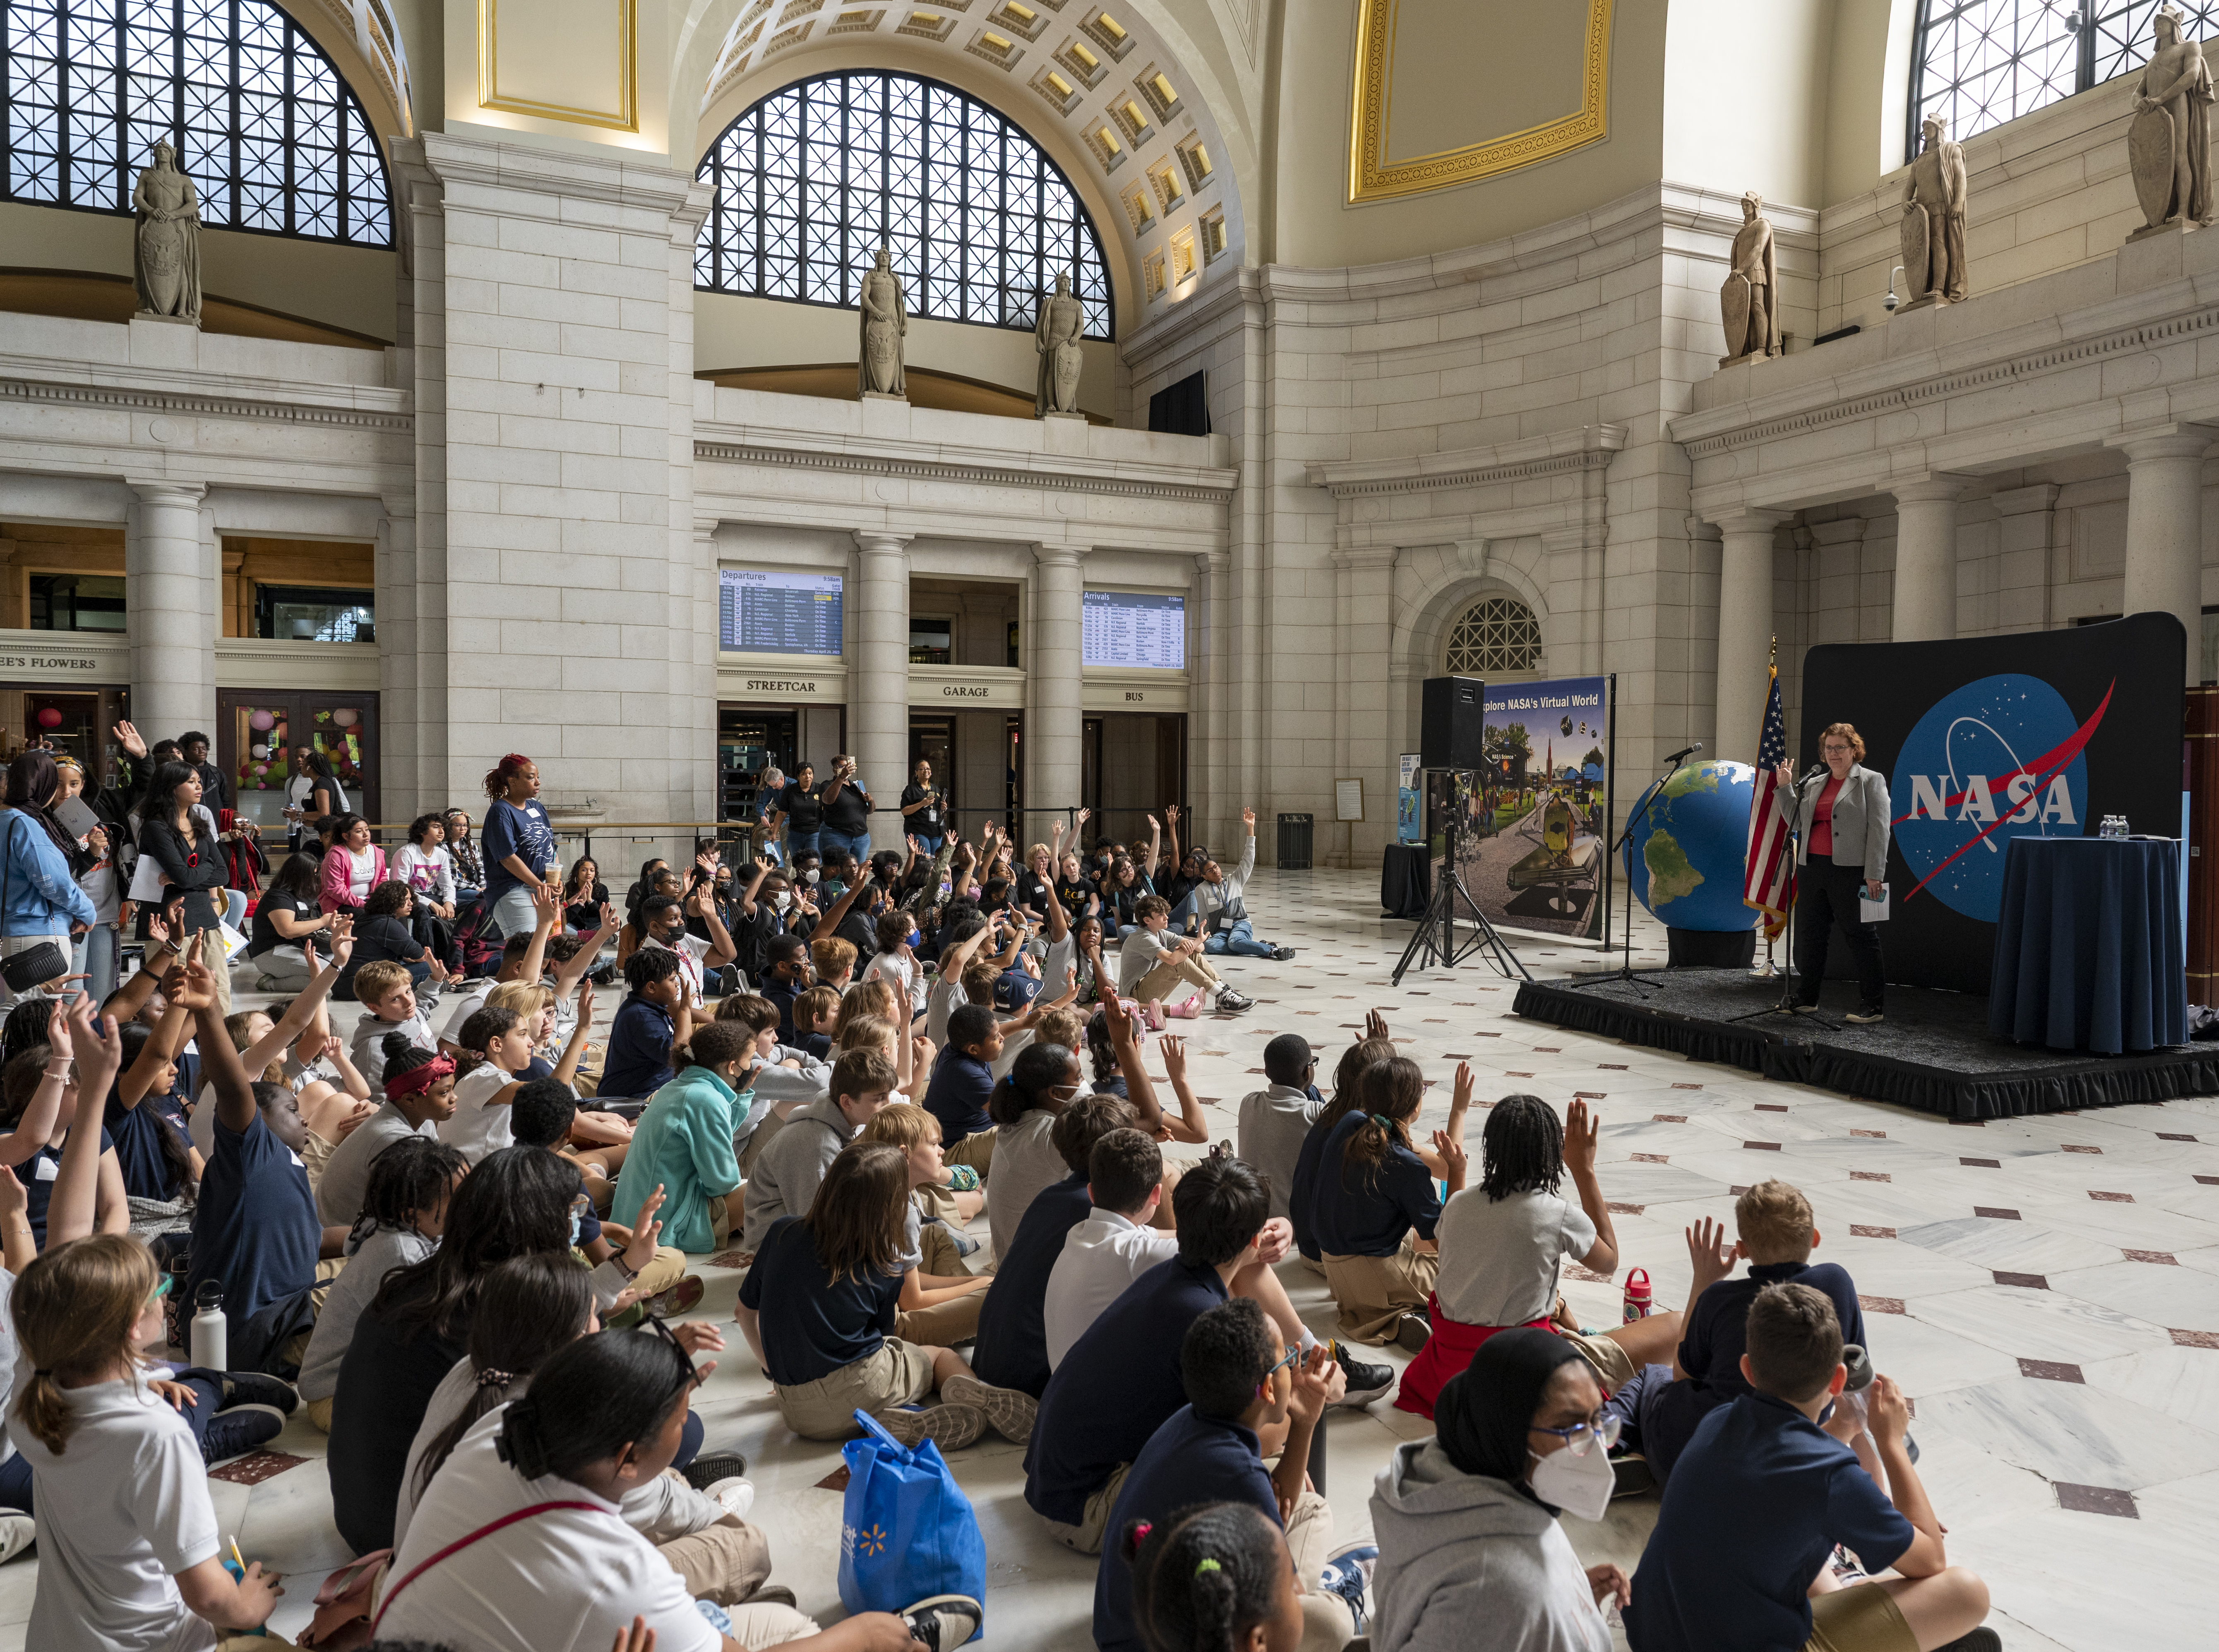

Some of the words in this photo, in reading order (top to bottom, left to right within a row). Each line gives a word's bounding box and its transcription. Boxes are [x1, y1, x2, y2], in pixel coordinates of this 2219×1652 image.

[722, 571, 766, 580] Departures
[1084, 592, 1110, 600] Arrivals
[31, 658, 96, 669] FLOWERS
[747, 680, 816, 692] STREETCAR
[943, 687, 989, 697] GARAGE
[1125, 692, 1143, 701] BUS
[1483, 701, 1505, 713] xplore
[1508, 698, 1538, 710] NASA's
[1540, 696, 1569, 708] Virtual
[1572, 694, 1598, 706] World
[1907, 773, 2077, 825] NASA
